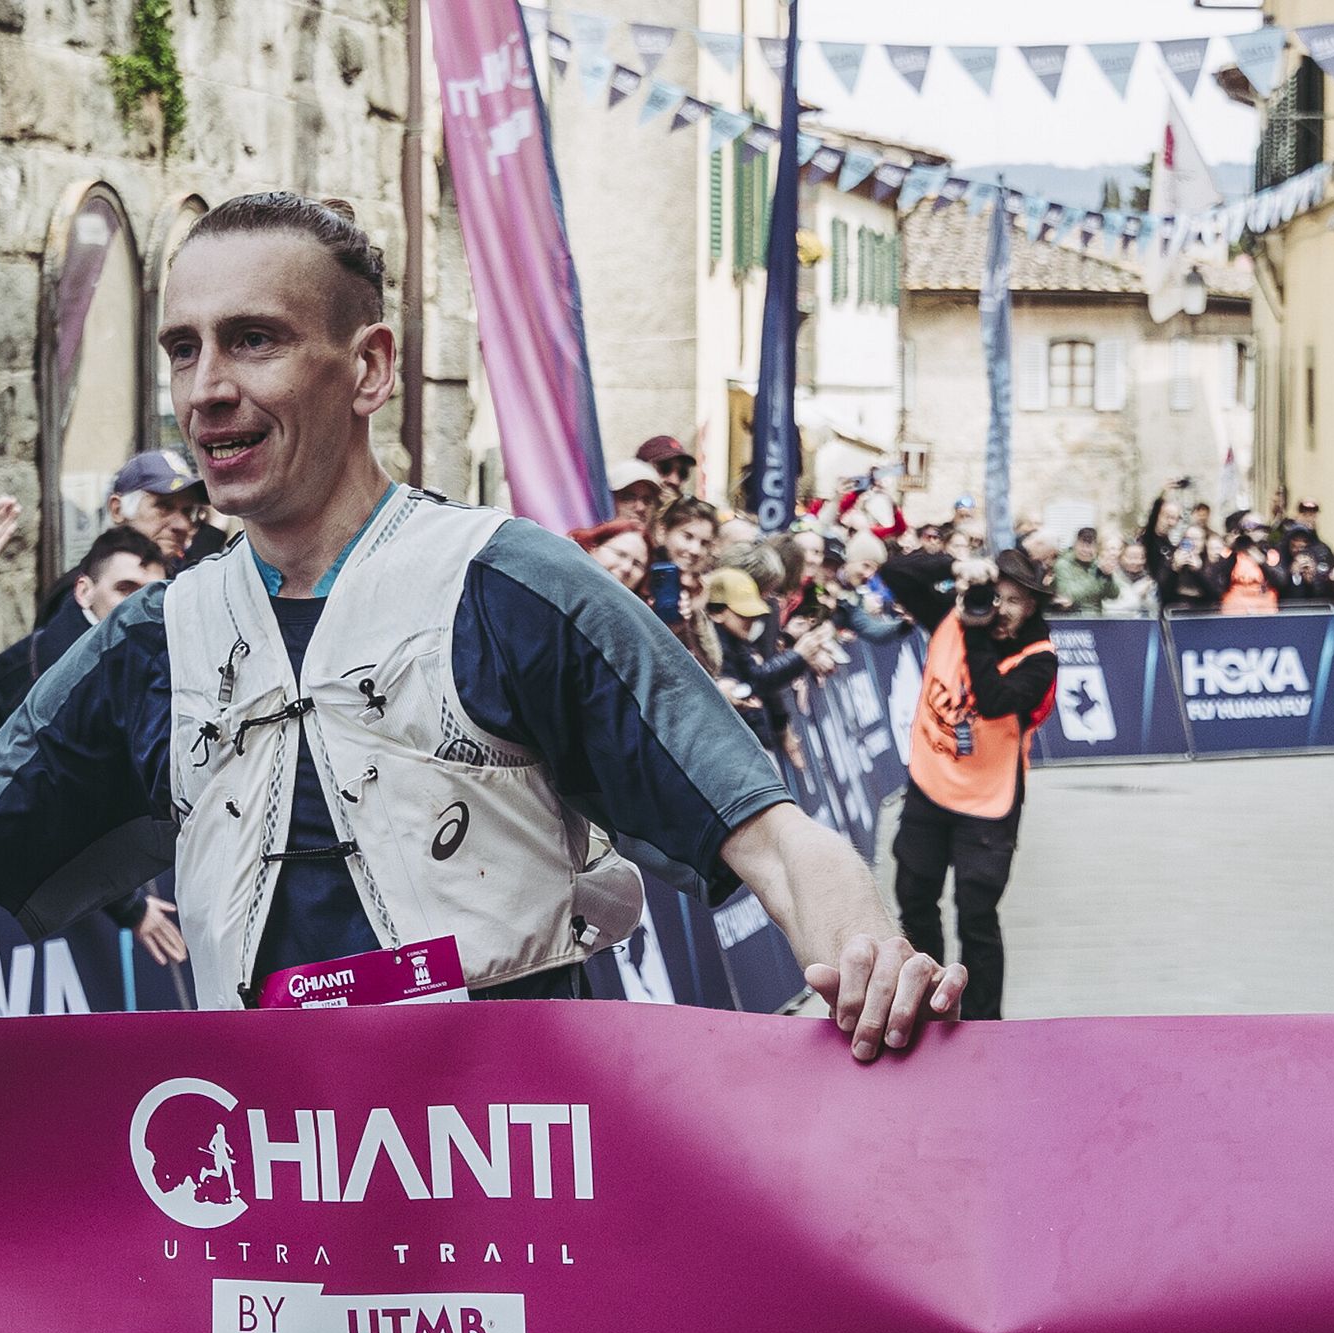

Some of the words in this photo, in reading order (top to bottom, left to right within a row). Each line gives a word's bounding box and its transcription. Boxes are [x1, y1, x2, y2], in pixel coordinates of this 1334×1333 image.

[1181, 645, 1310, 696] HOKA
[288, 969, 355, 998] CHIANTI
[129, 1076, 595, 1229] CHIANTI
[163, 1239, 331, 1266] ULTRA
[393, 1242, 574, 1266] TRAIL
[238, 1294, 286, 1333] BY
